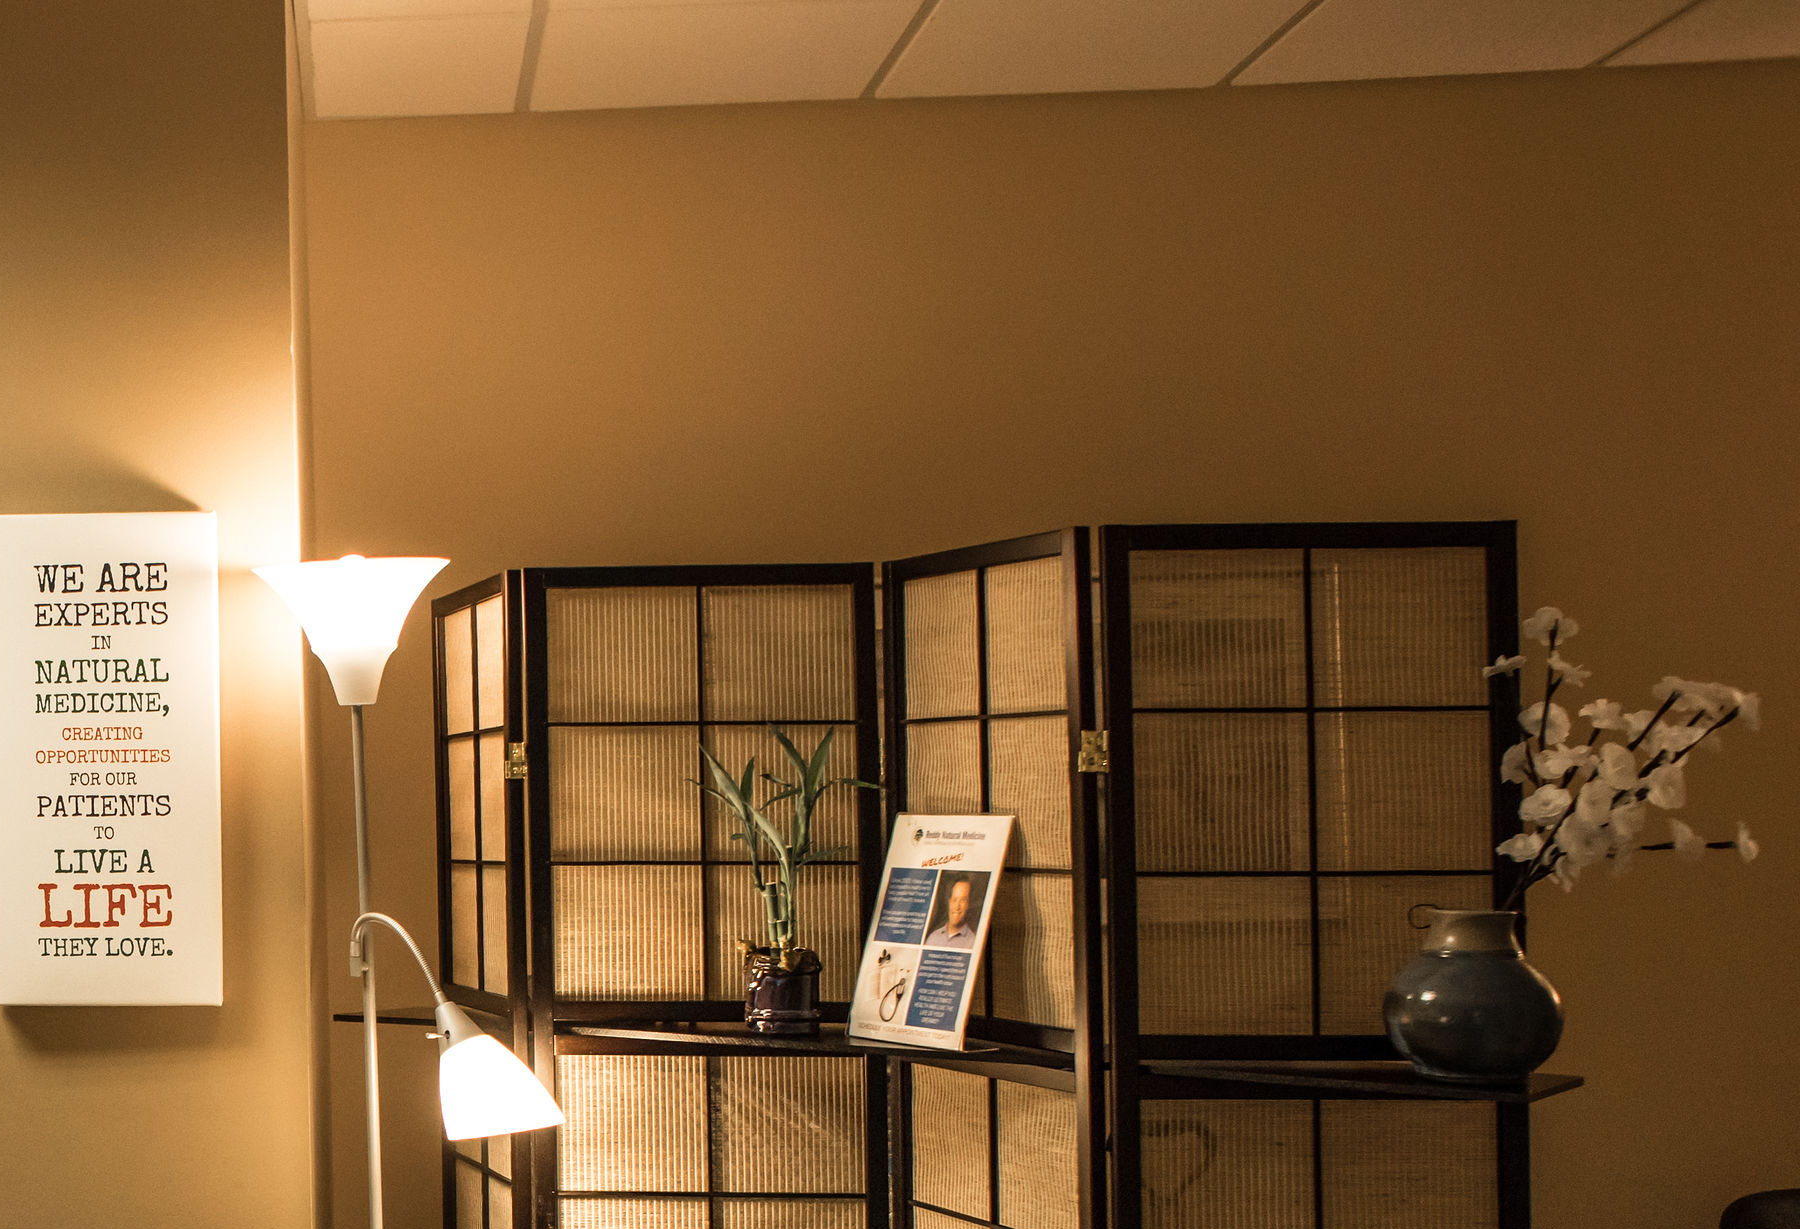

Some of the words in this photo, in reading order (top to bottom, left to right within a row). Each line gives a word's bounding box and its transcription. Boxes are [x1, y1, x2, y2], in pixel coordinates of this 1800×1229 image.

[33, 564, 84, 594] WE
[95, 562, 168, 593] ARE
[34, 601, 169, 627] EXPERTS
[91, 635, 112, 650] IN
[34, 658, 170, 684] NATURAL
[35, 692, 170, 717] MEDICINE,
[61, 726, 144, 741] CREATING
[35, 749, 171, 764] OPPORTUNITIES
[69, 772, 102, 786] FOR
[105, 771, 137, 786] OUR
[37, 794, 172, 818] PATIENTS
[93, 826, 115, 840] TO
[54, 849, 128, 874] LIVE
[136, 849, 156, 873] A
[37, 883, 173, 928] LIFE
[38, 937, 99, 957] THEY
[105, 936, 174, 957] LOVE.
